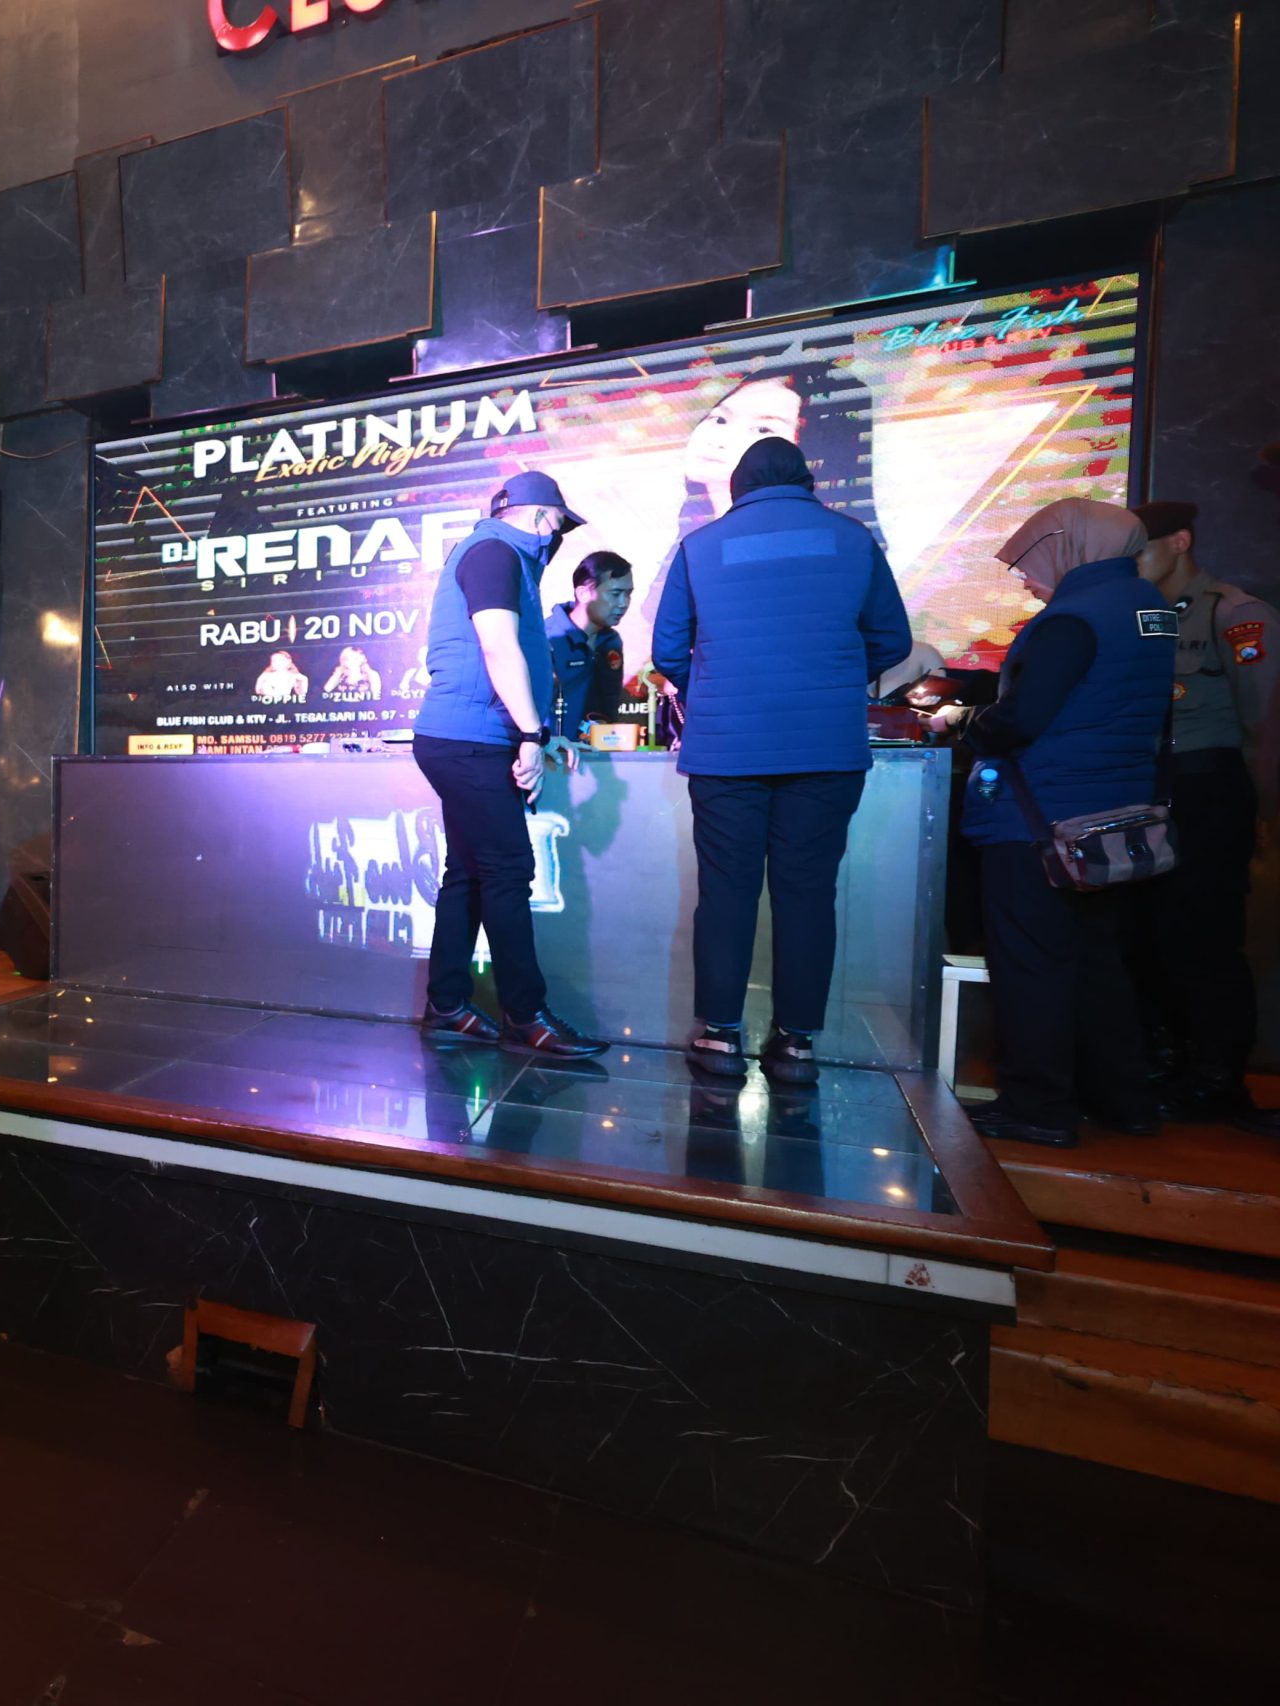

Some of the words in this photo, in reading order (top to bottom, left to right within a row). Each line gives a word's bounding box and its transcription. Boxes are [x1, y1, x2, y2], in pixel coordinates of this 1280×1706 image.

[881, 320, 979, 351] Blue
[992, 298, 1086, 340] Fish
[193, 389, 537, 478] PLATINUM
[254, 451, 346, 483] Exotic
[351, 433, 462, 477] Night
[297, 497, 394, 518] FEATURING
[161, 540, 197, 564] DJ
[200, 560, 414, 592] SIRIUS
[200, 618, 281, 647] RABU
[304, 614, 341, 640] 20
[349, 608, 420, 638] NOV
[166, 683, 197, 692] ALSO
[203, 682, 234, 691] WITH
[156, 716, 182, 727] BLUE
[183, 716, 206, 726] FISH
[207, 715, 234, 725] CLUB
[235, 714, 245, 724] &
[246, 714, 267, 724] KTV
[275, 713, 292, 723] JL.
[294, 711, 356, 723] TEGALSARI
[358, 710, 378, 721] NO.
[618, 702, 649, 714] LUE
[198, 745, 227, 755] AMI
[220, 735, 266, 745] SAMSUL
[270, 734, 297, 744] 0819
[300, 733, 326, 743] 5277
